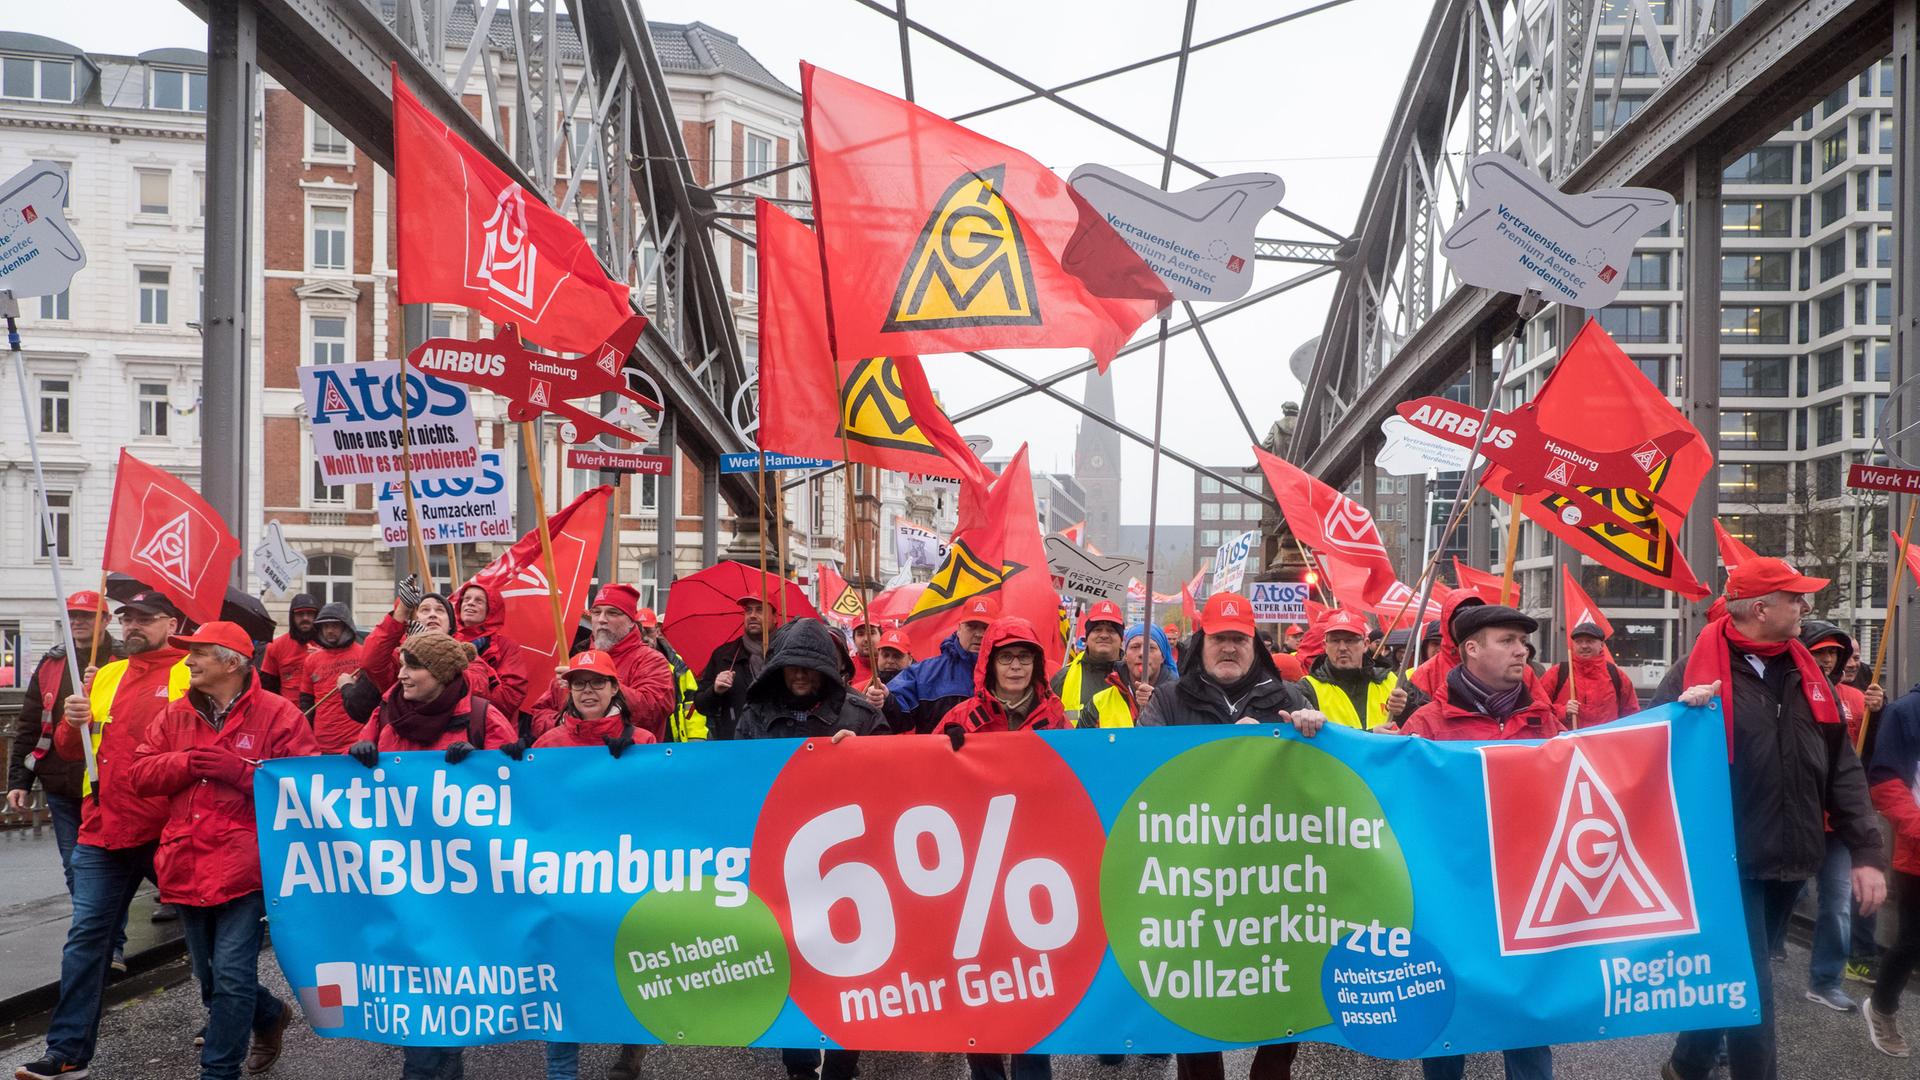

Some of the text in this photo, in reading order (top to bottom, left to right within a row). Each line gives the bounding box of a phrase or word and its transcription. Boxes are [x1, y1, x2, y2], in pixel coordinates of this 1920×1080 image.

[1106, 212, 1201, 262] Vertrauensleute
[1497, 203, 1577, 266] Vertrauensleute
[1167, 254, 1217, 283] Aerotec
[1496, 221, 1544, 261] Premium
[1543, 253, 1587, 290] Aerotec
[1518, 253, 1578, 300] Nordenham
[419, 348, 506, 377] AIRBUS
[529, 361, 578, 381] Hamburg
[333, 429, 364, 451] Ohne
[364, 430, 388, 448] uns
[417, 423, 459, 444] nichts.
[1409, 404, 1517, 449] AIRBUS
[323, 453, 357, 476] Wollt
[357, 453, 374, 473] Ihr
[376, 454, 391, 472] es
[576, 453, 663, 473] Werk Hamburg
[729, 457, 761, 468] Werk
[1544, 439, 1599, 472] Hamburg
[1861, 470, 1920, 489] Werk H
[422, 500, 497, 519] Rumzackern!
[384, 518, 510, 542] Geb ns M+Ehr Geld!
[264, 565, 287, 592] BREMEN
[1068, 580, 1108, 598] VAREL
[1069, 571, 1123, 591] AEROTEC
[1254, 604, 1280, 612] SUPER
[273, 766, 513, 831] Aktiv bei
[1138, 801, 1384, 849] individueller
[279, 833, 752, 908] AIRBUS Hamburg
[783, 793, 1080, 978] 6%
[1138, 854, 1327, 907] Anspruch
[1138, 903, 1412, 958] auf verkürzte
[628, 934, 739, 973] Das haben
[1612, 949, 1712, 986] Region
[360, 963, 559, 996] MITEINANDER
[637, 950, 775, 1001] wir verdient!
[840, 953, 1055, 1022] mehr Geld
[1138, 954, 1291, 999] Vollzeit
[1334, 959, 1442, 986] Arbeitszeiten,
[1337, 977, 1446, 1006] die zum Leben
[1614, 979, 1747, 1010] Hamburg
[363, 997, 564, 1037] FÜR MORGEN
[1342, 1007, 1398, 1027] passen!
